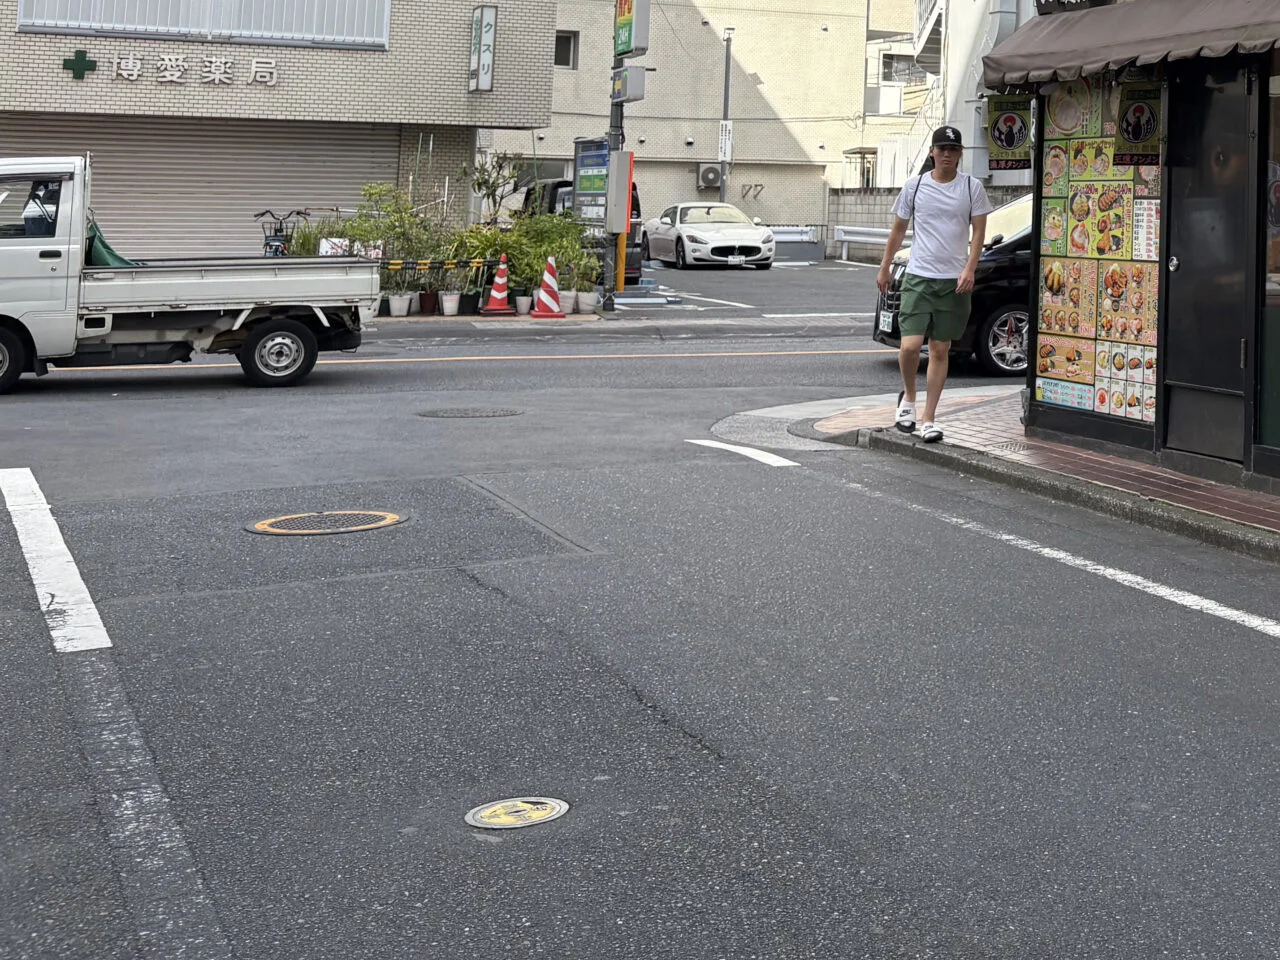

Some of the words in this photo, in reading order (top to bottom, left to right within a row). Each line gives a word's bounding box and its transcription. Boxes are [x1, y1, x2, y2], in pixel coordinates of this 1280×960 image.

[111, 51, 278, 86] 博愛薬局
[482, 22, 493, 75] クスリ
